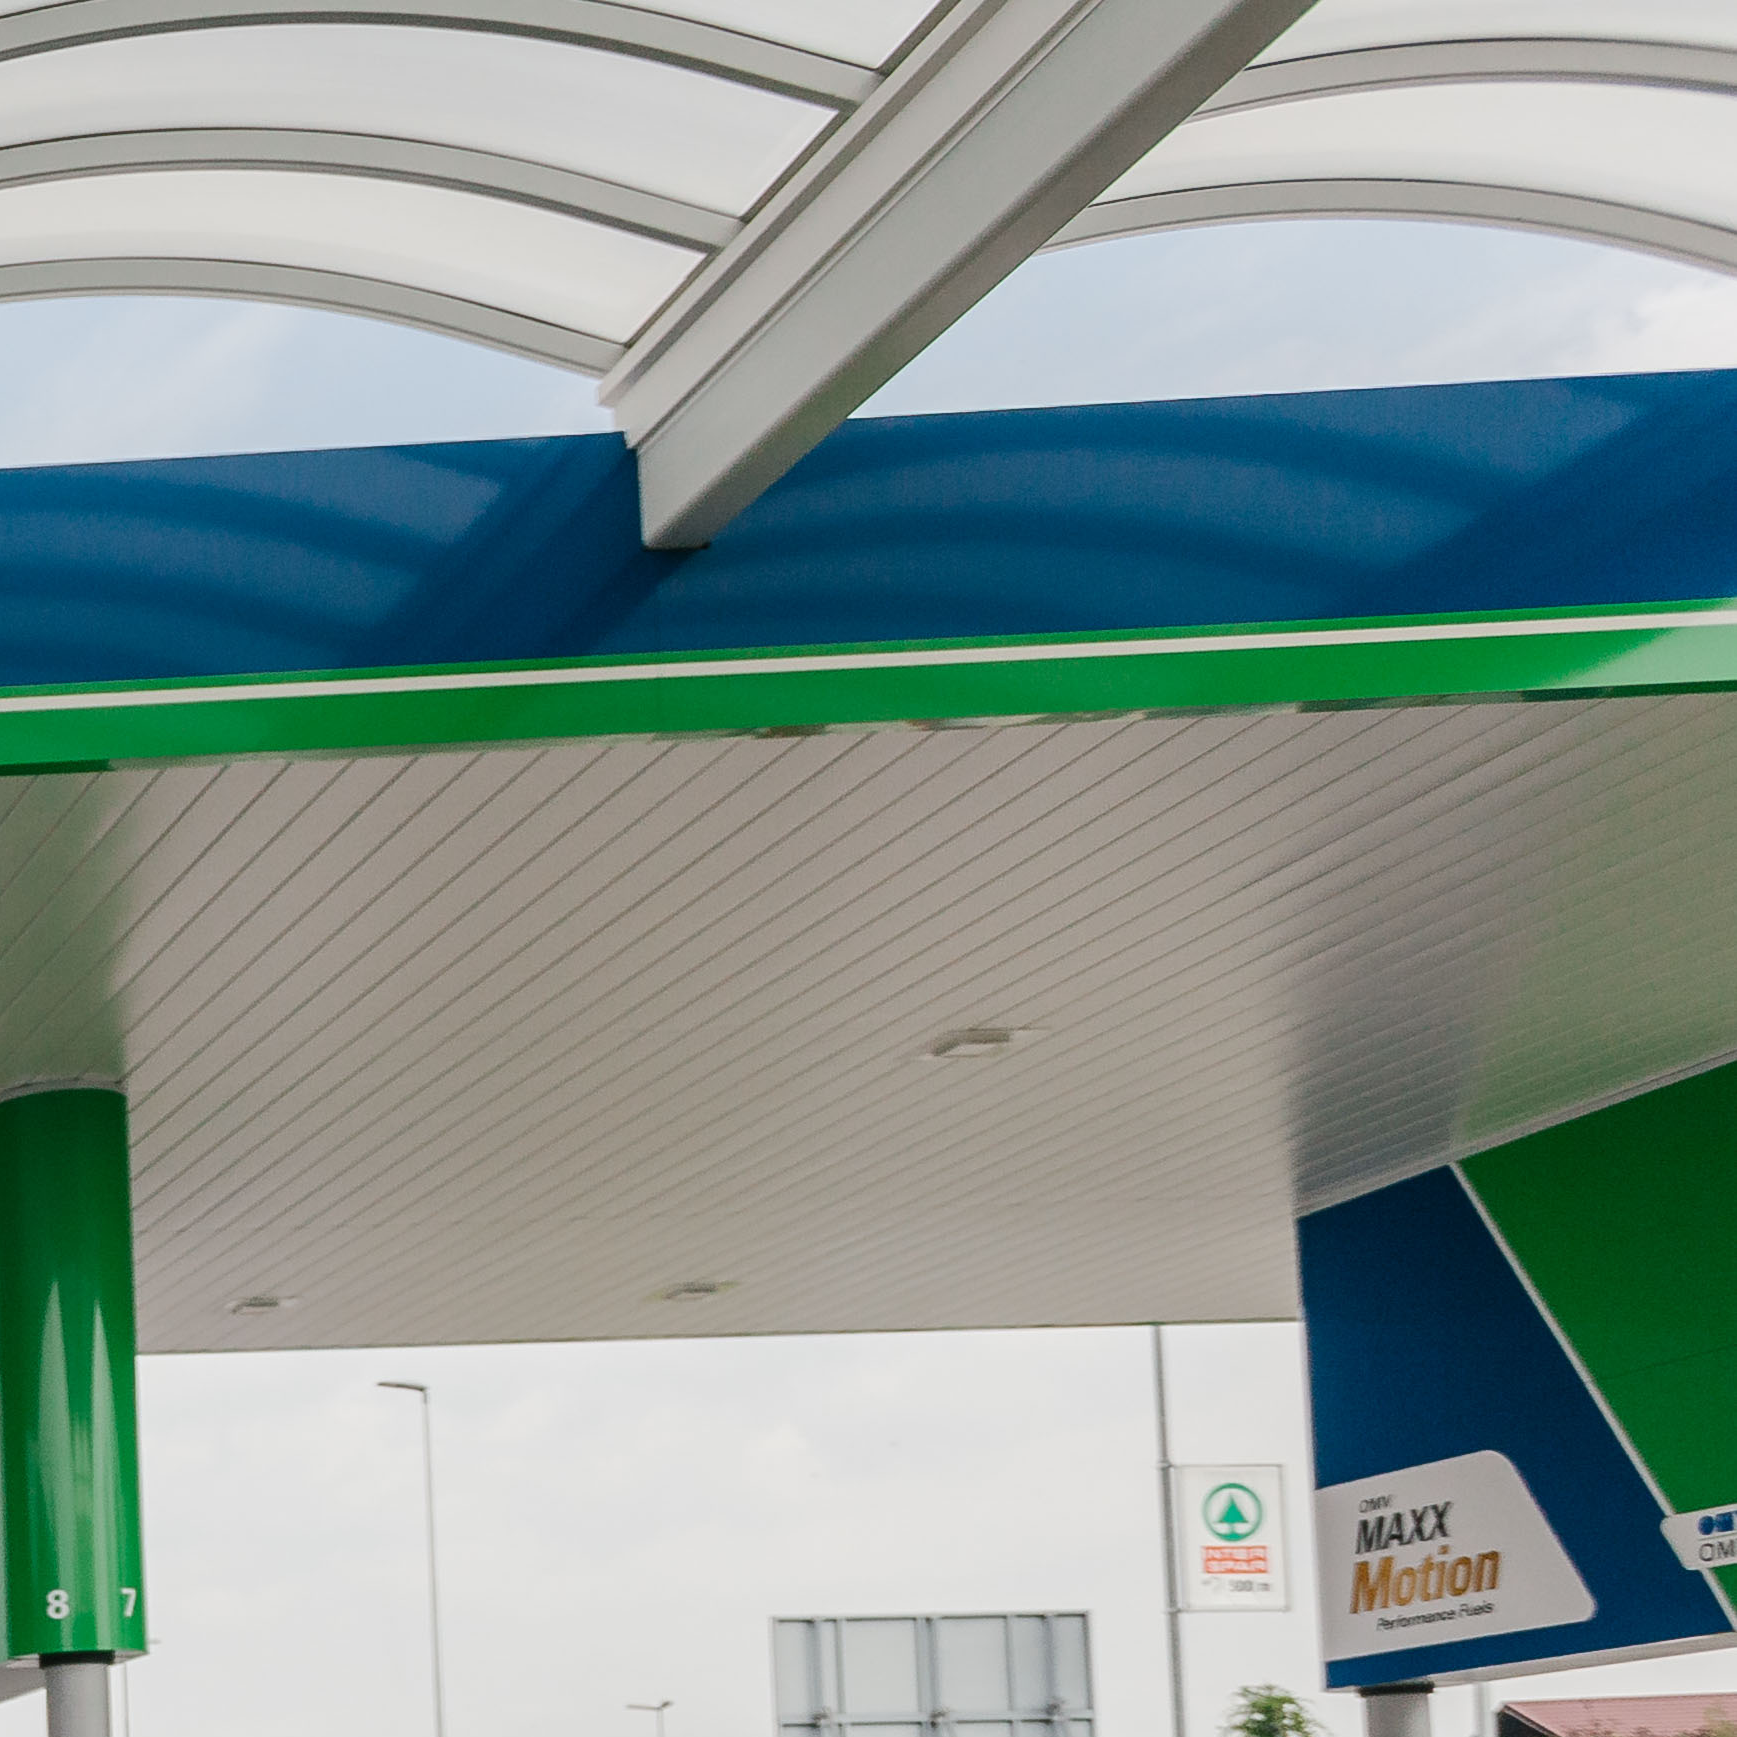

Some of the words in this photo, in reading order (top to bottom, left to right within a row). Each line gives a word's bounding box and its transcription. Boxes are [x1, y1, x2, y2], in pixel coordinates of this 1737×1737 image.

[1355, 1501, 1452, 1554] MAXX
[1699, 1539, 1736, 1561] OM
[1350, 1545, 1501, 1614] Motion
[46, 1589, 70, 1620] 8
[121, 1588, 137, 1618] 7
[1377, 1608, 1456, 1631] Performance
[1458, 1601, 1495, 1617] Fuels
